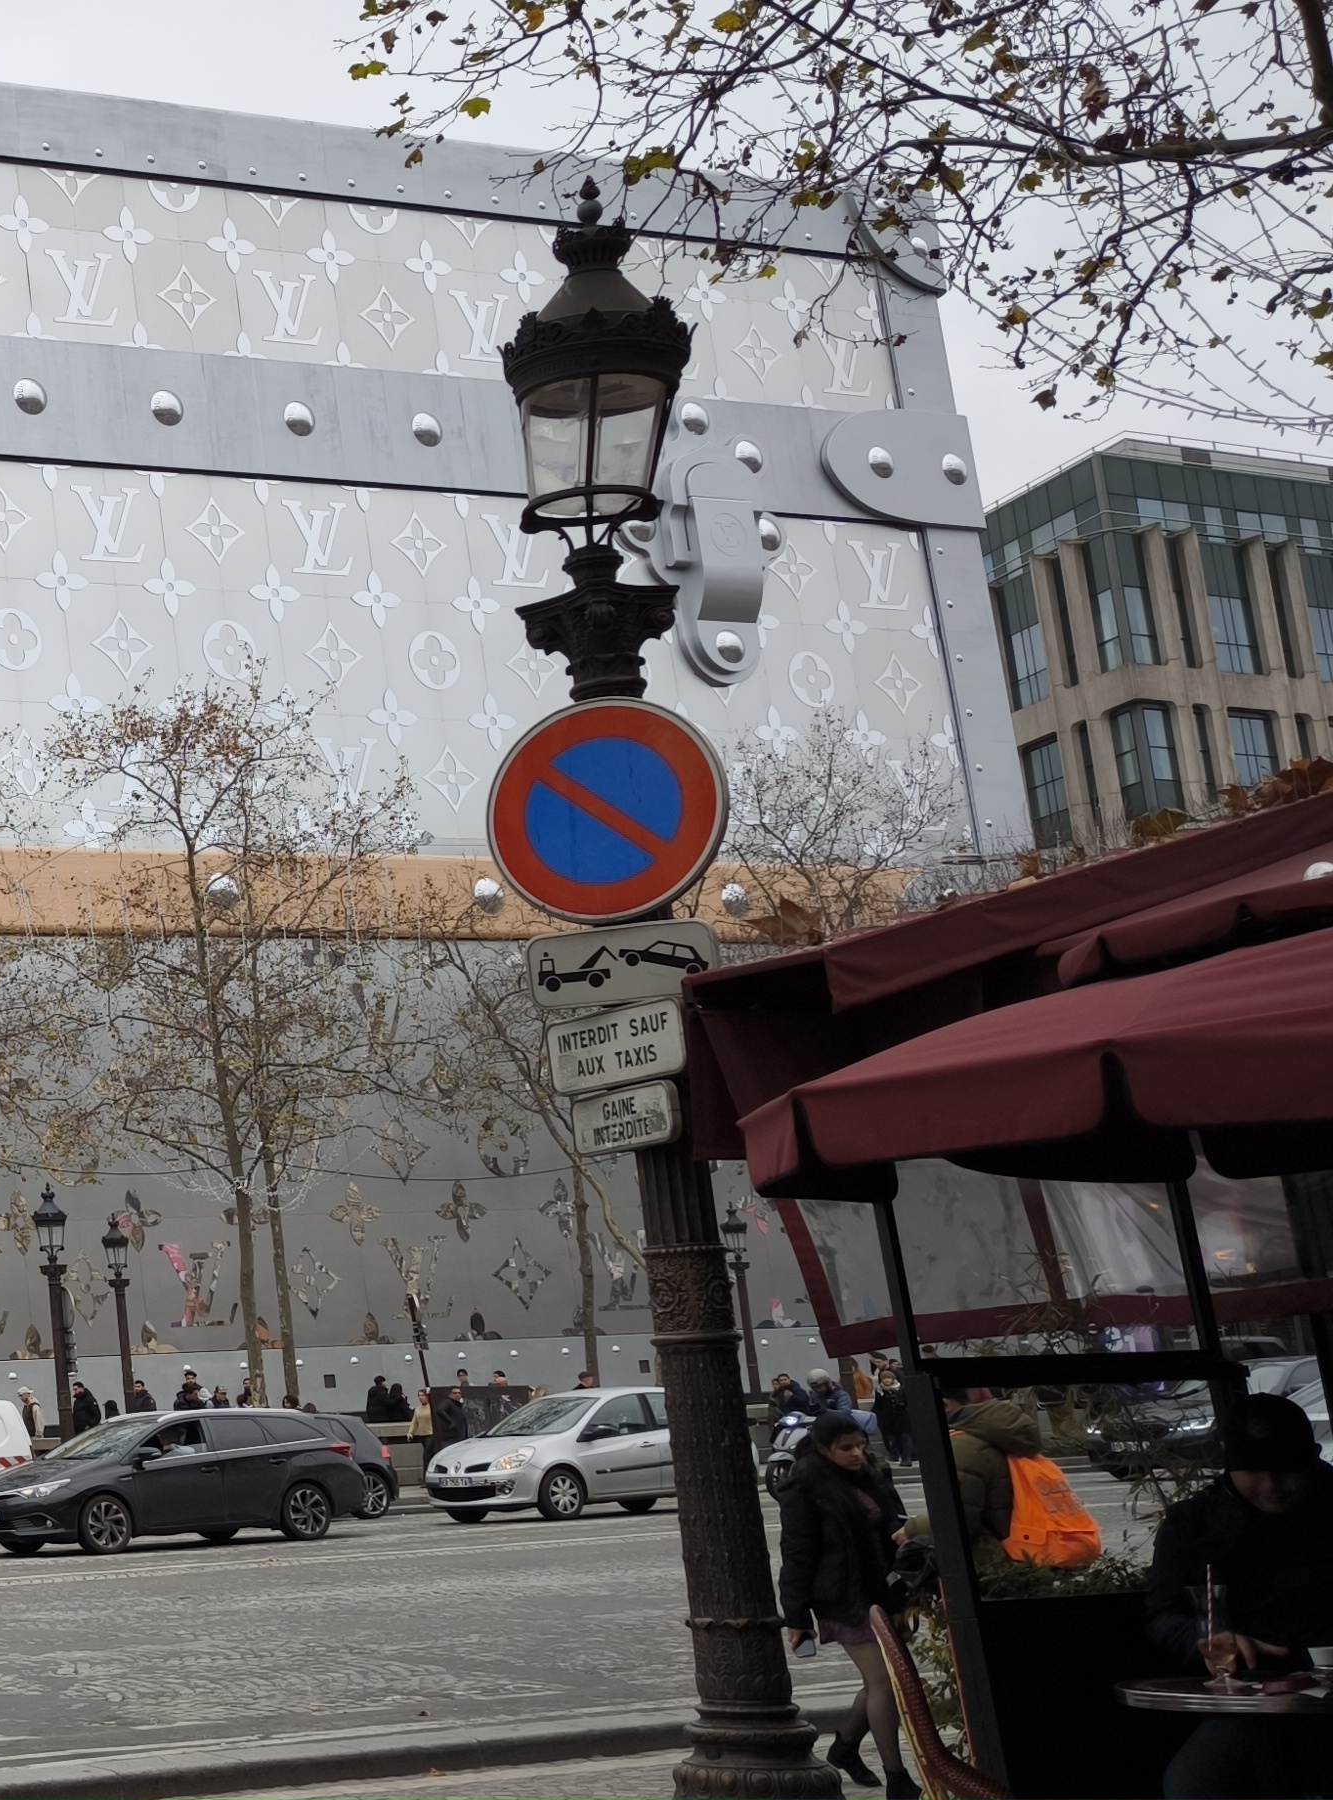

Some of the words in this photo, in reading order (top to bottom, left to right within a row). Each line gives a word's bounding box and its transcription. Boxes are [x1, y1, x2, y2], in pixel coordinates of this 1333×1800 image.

[558, 1023, 618, 1053] INTERDIT
[629, 1012, 668, 1037] SAUF
[577, 1055, 605, 1077] AUX
[615, 1044, 657, 1069] TAXIS
[602, 1096, 637, 1120] GAINE
[593, 1117, 652, 1146] INTERDITE
